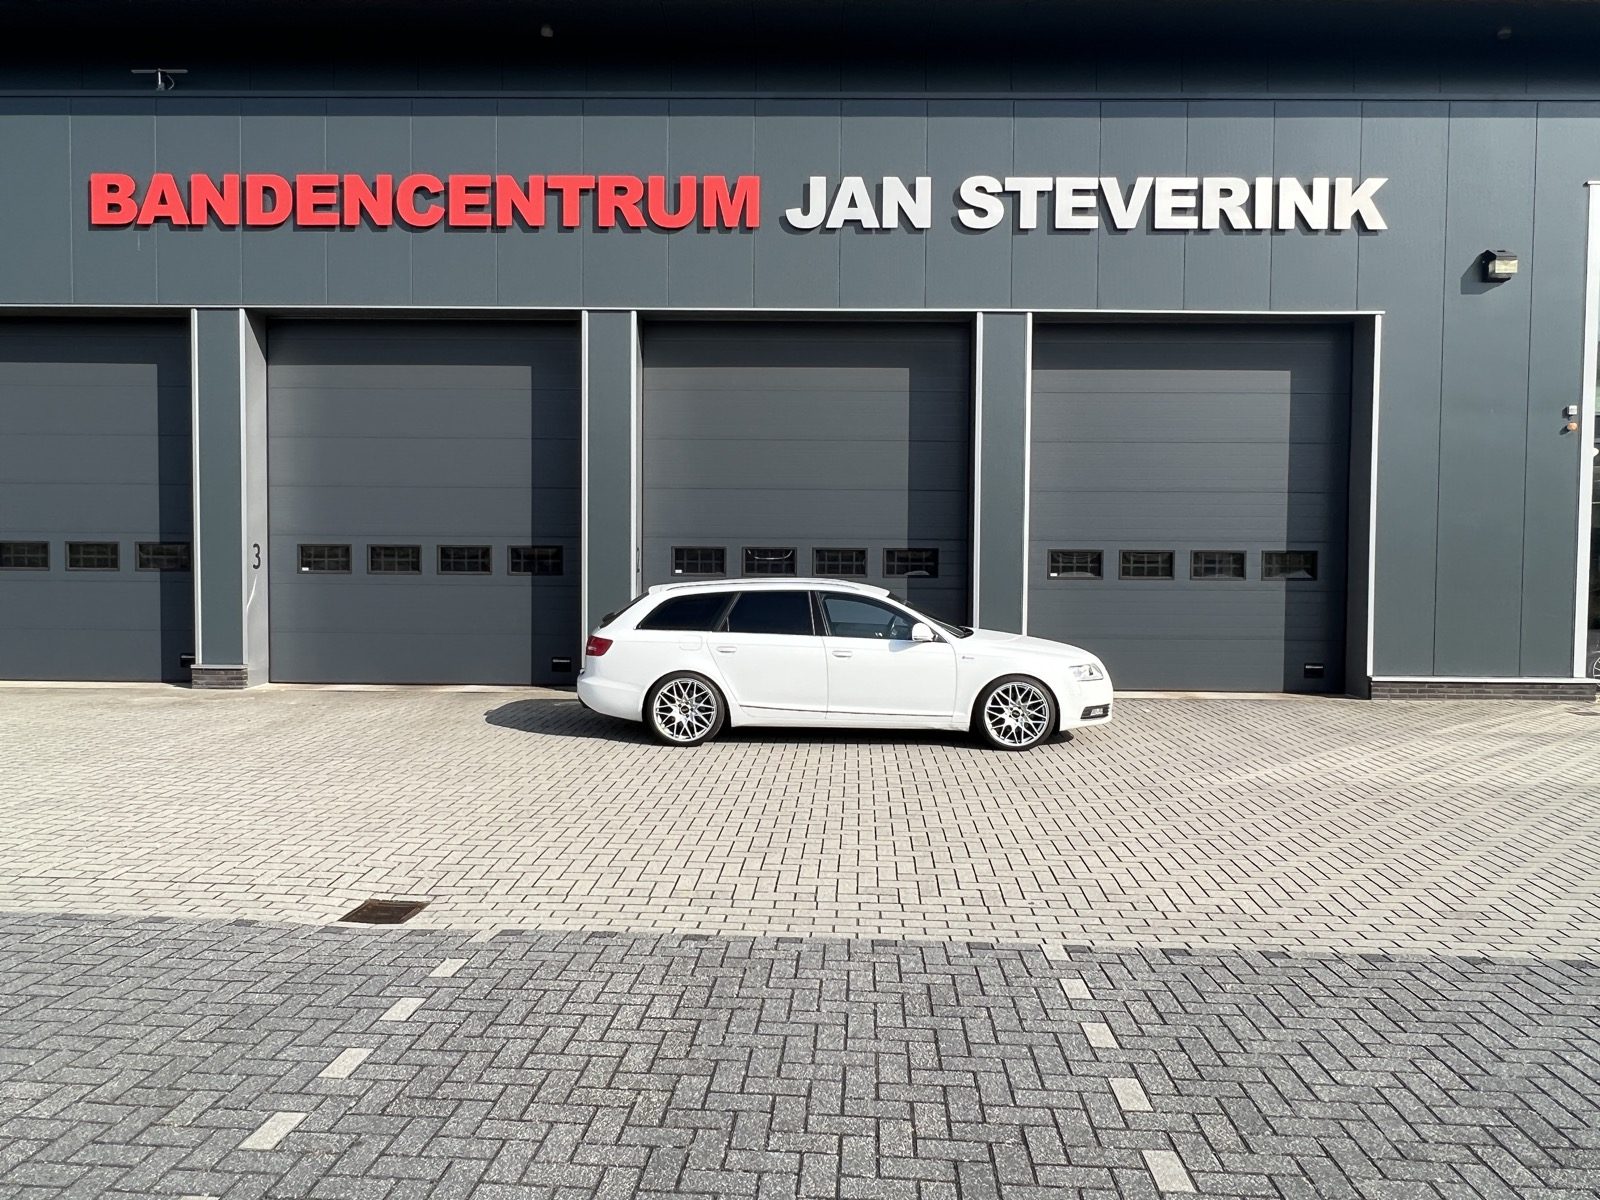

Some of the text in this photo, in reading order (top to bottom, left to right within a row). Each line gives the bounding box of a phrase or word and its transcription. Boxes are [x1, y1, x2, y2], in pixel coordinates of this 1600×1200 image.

[90, 172, 1389, 230] BANDENCENTRUM JAN STEVERINK
[252, 543, 261, 570] 3
